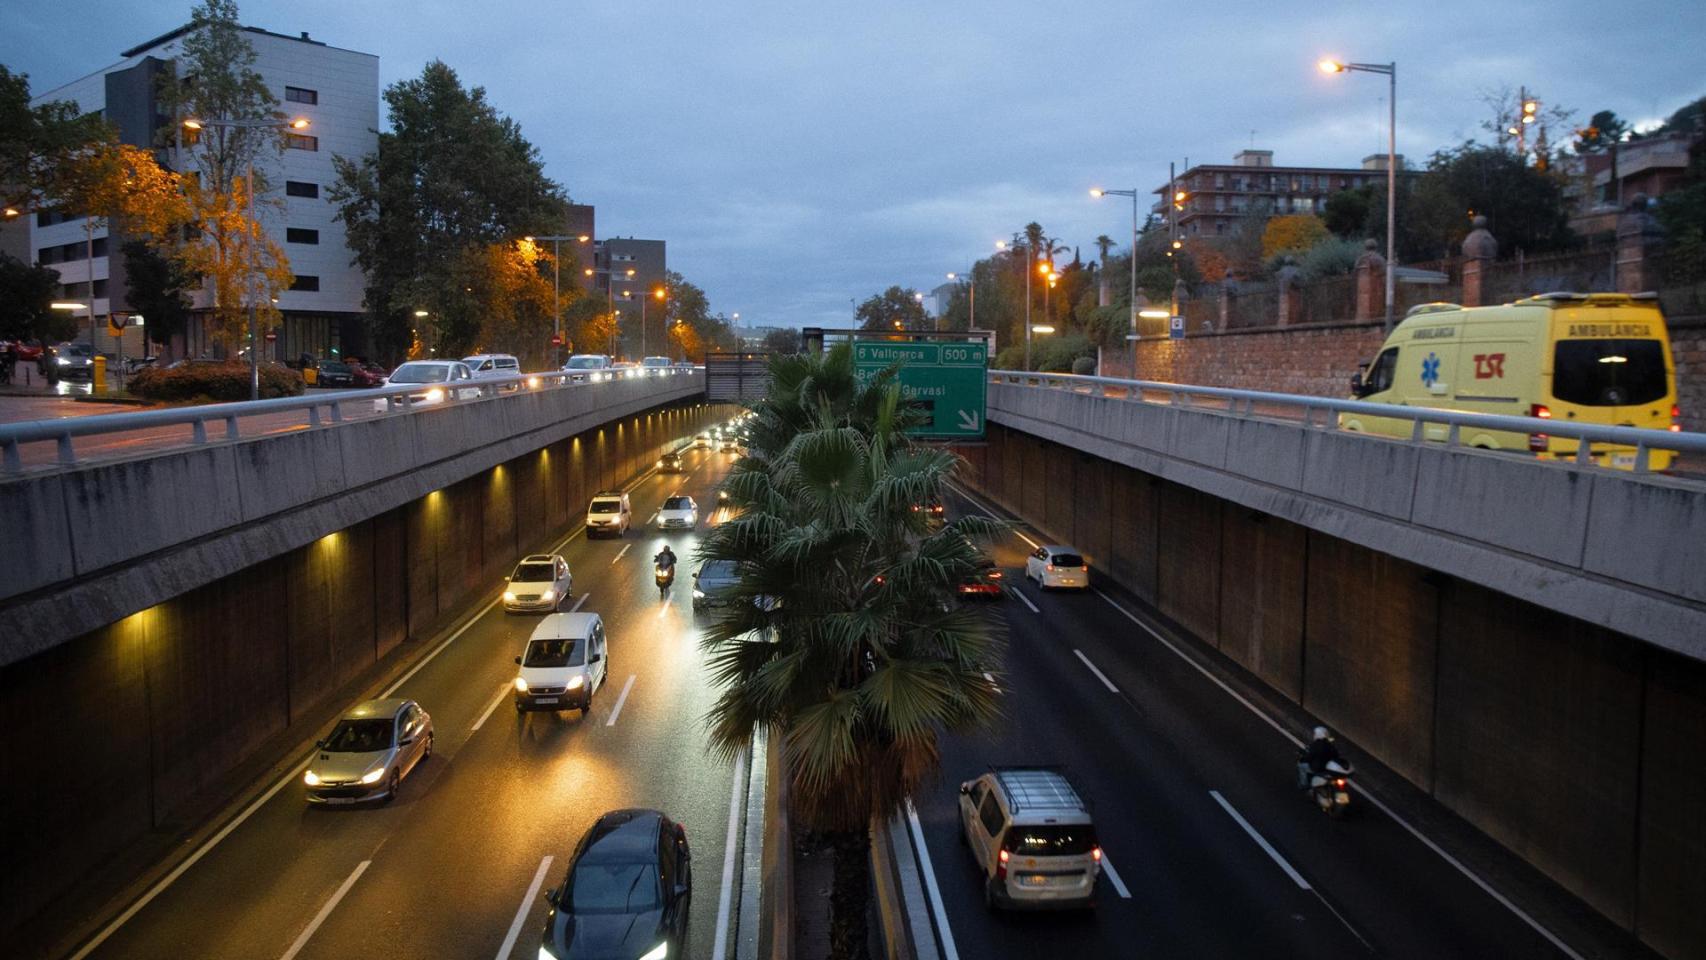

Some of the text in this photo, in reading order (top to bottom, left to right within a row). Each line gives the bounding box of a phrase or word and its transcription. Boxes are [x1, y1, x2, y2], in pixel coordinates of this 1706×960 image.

[1568, 324, 1652, 337] AMBULANCIA
[871, 348, 924, 359] Vallcarca
[945, 349, 982, 361] 500 m
[903, 384, 946, 395] Gervasi
